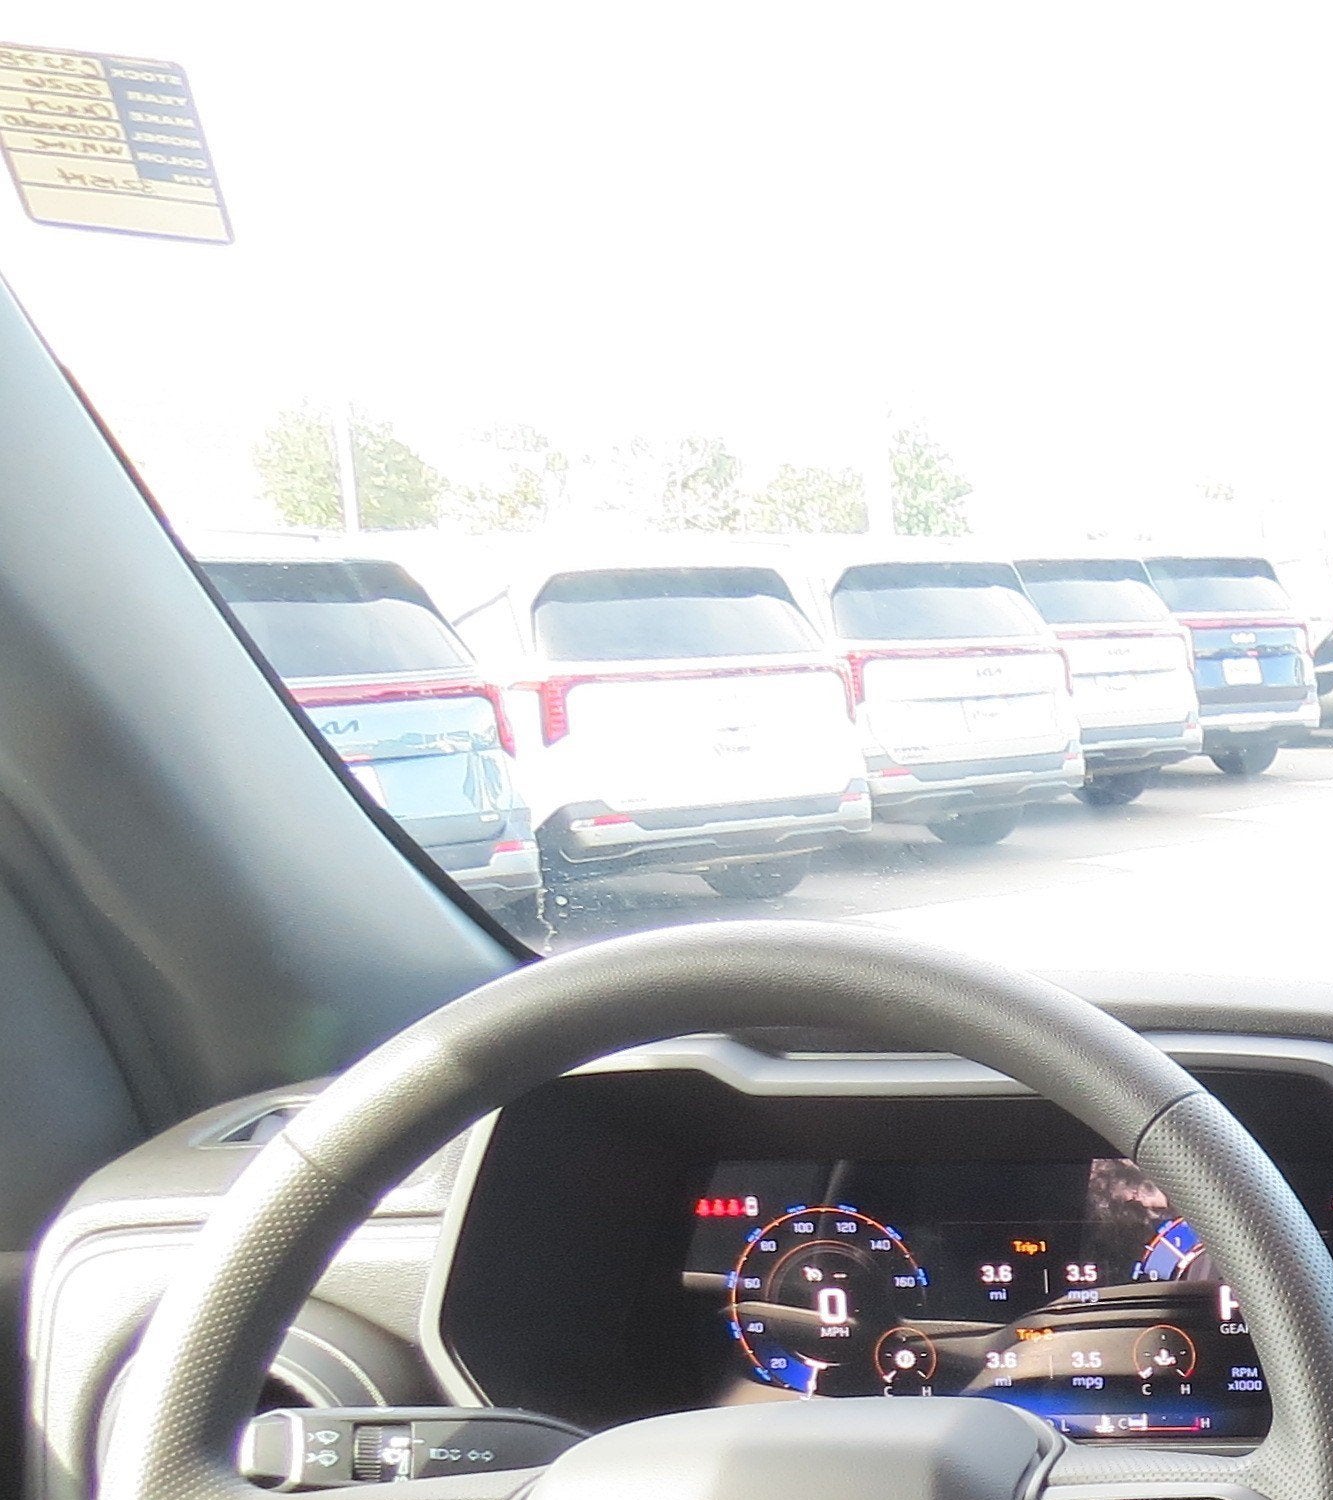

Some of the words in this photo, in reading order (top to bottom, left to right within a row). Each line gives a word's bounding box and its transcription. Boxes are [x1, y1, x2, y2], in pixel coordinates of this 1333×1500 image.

[1013, 1240, 1038, 1255] Trip
[1066, 1264, 1098, 1282] 3.5
[990, 1289, 1007, 1300] mi
[1067, 1291, 1099, 1303] mpg
[820, 1327, 850, 1338] MPH
[1071, 1352, 1102, 1368] 3.5
[1231, 1367, 1258, 1378] RPM
[1072, 1378, 1104, 1390] mpg
[1227, 1380, 1263, 1392] x1000
